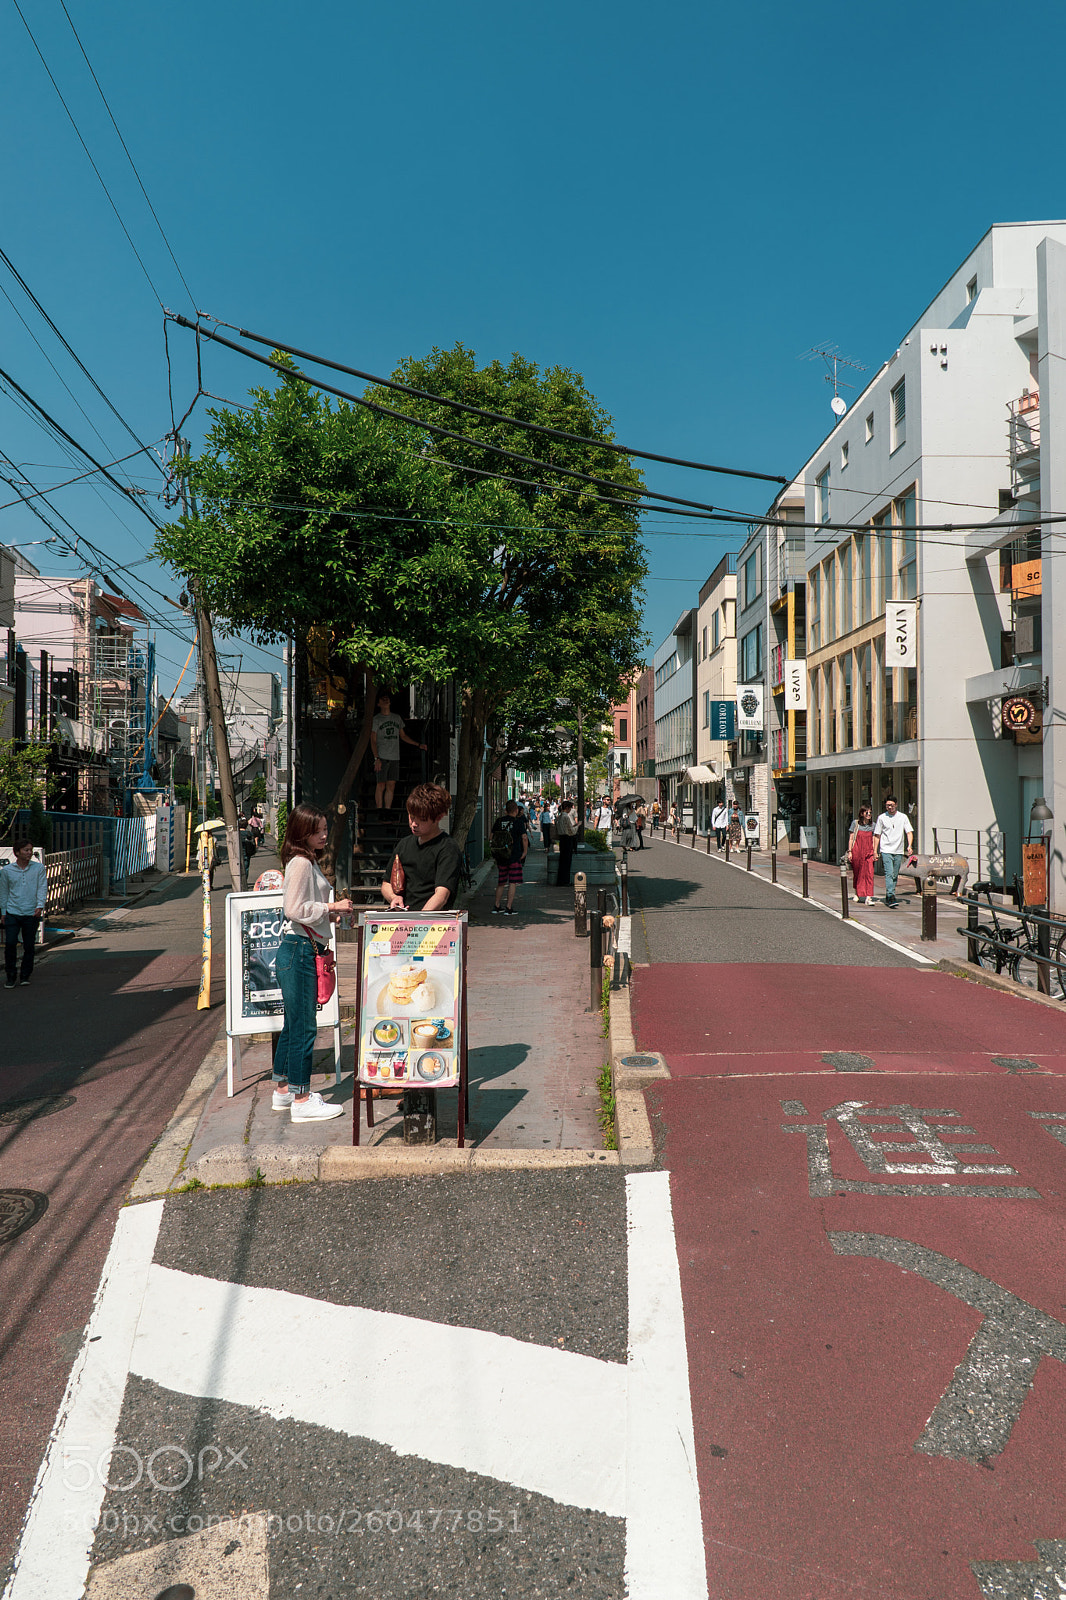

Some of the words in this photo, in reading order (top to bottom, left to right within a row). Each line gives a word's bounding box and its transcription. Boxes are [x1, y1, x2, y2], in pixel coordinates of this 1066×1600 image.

[1026, 571, 1041, 581] SC
[895, 608, 908, 656] GRAIN
[791, 668, 801, 702] GRAIN
[718, 702, 728, 739] CORLEONE
